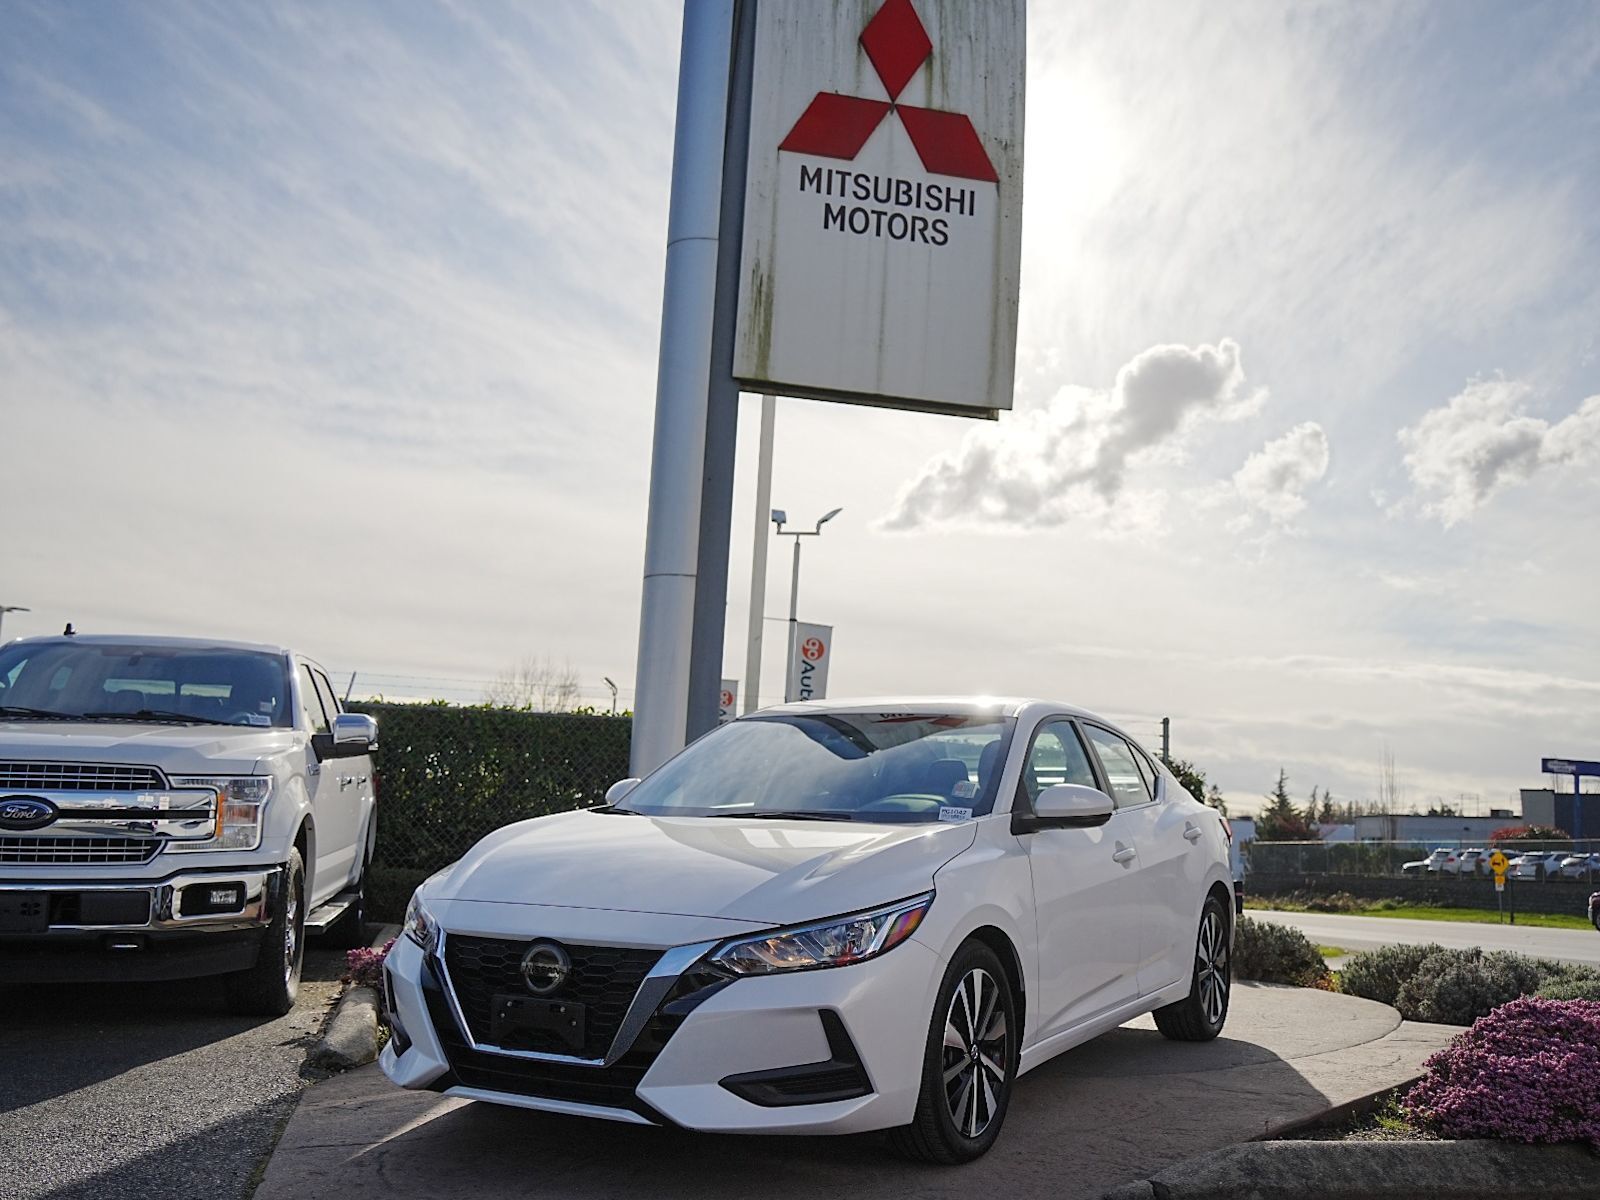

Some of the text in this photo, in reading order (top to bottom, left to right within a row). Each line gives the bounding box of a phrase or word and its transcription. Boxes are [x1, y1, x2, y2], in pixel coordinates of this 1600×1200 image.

[800, 164, 975, 217] MITSUBISHI
[823, 202, 949, 246] MOTORS
[2, 804, 38, 819] Ford
[521, 961, 568, 977] NISSAN
